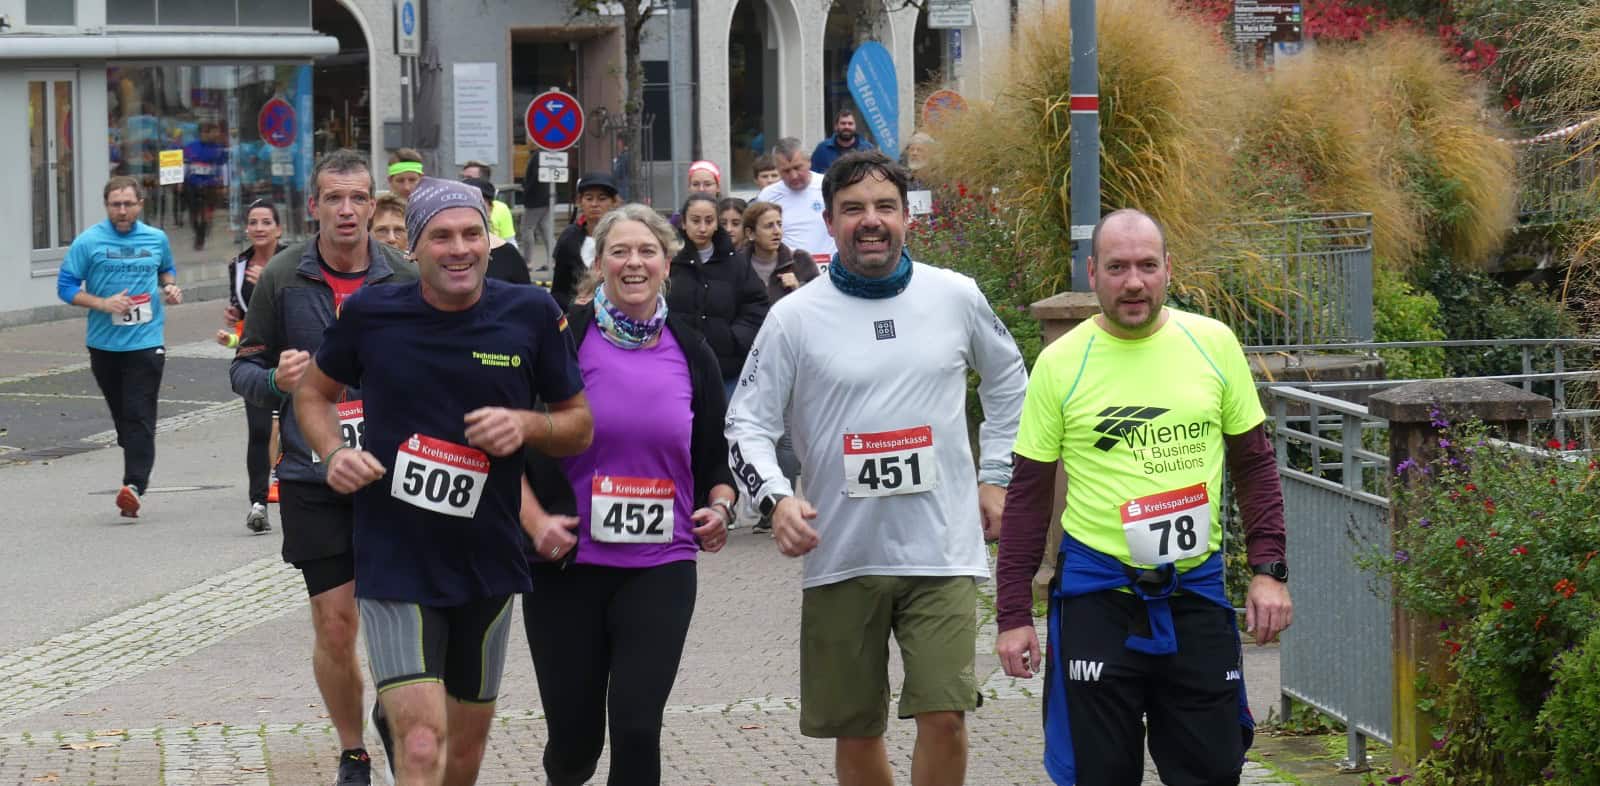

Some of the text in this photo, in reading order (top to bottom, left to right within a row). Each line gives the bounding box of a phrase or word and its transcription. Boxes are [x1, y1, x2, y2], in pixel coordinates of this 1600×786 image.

[858, 83, 897, 149] Hermes
[866, 436, 928, 449] Kreissparkasse
[1133, 442, 1206, 462] IT Business
[421, 444, 485, 469] Kreissparkasse
[1143, 457, 1205, 475] Solutions
[858, 452, 922, 490] 451
[402, 460, 475, 508] 508
[615, 484, 672, 496] Kreissparkasse
[1144, 493, 1205, 514] Kreissparkasse
[602, 502, 665, 536] 452
[1149, 515, 1197, 557] 78
[1069, 659, 1104, 681] MW
